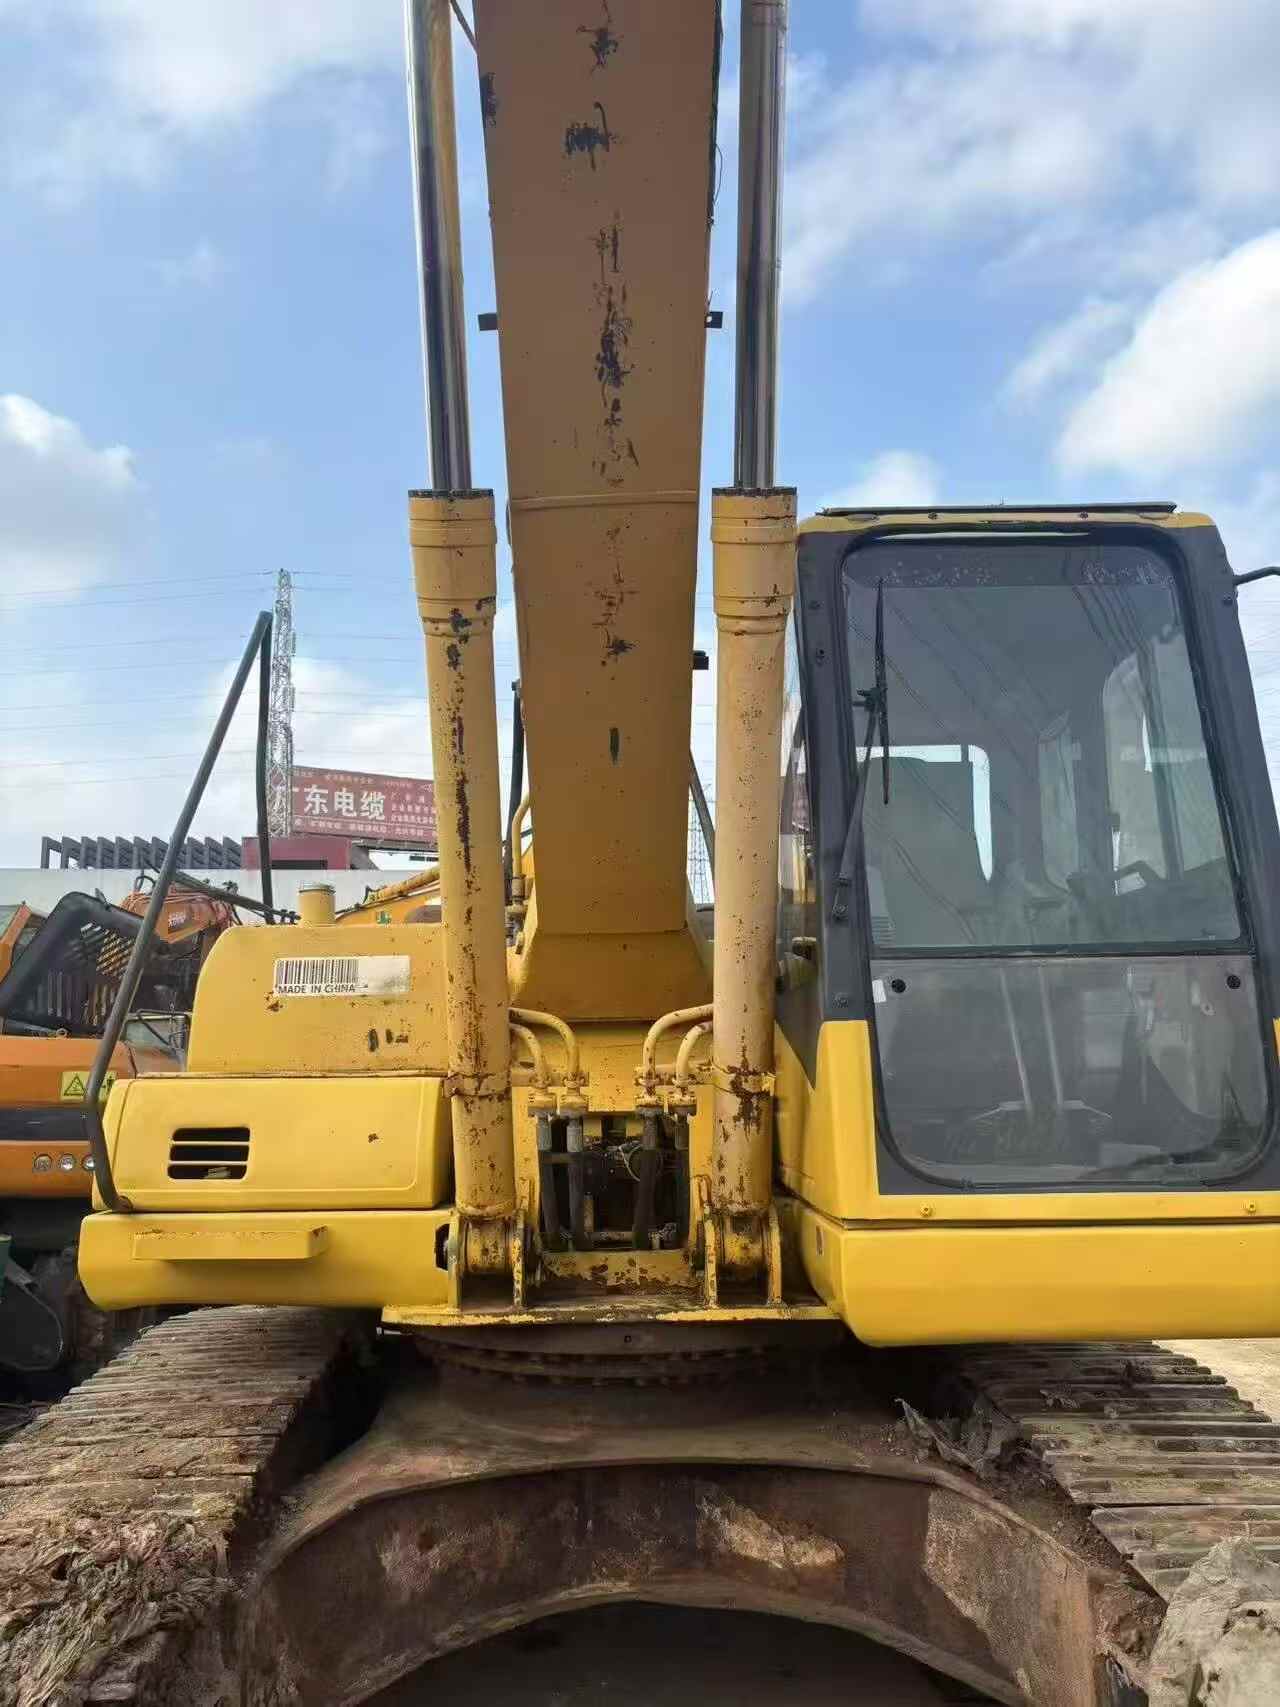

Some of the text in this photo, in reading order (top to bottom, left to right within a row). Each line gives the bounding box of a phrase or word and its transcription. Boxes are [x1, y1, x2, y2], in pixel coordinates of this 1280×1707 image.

[291, 784, 386, 821] 东电缆
[278, 984, 356, 994] MADE IN CHINA
